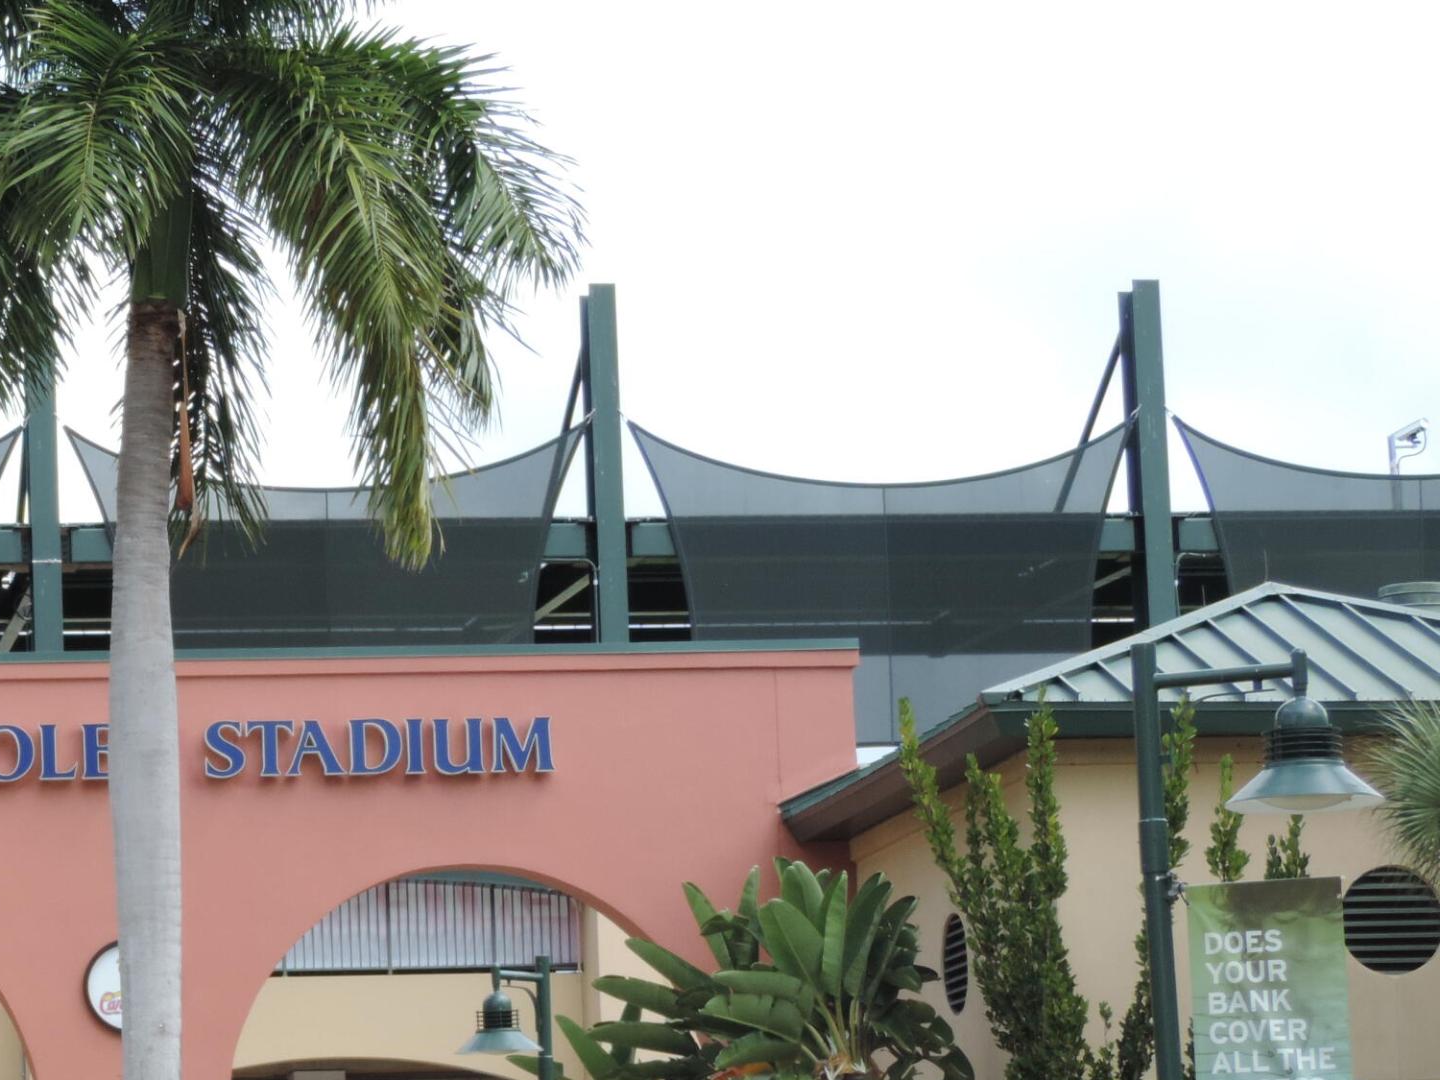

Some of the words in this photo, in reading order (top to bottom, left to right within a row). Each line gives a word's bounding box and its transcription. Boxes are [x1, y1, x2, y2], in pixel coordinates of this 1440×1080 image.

[203, 715, 555, 778] STADIUM
[1204, 929, 1283, 955] DOES
[1206, 959, 1287, 984] YOUR
[1208, 989, 1292, 1015] BANK
[1209, 1018, 1308, 1045] COVER
[1212, 1051, 1269, 1074] ALL
[1277, 1047, 1336, 1071] THE
